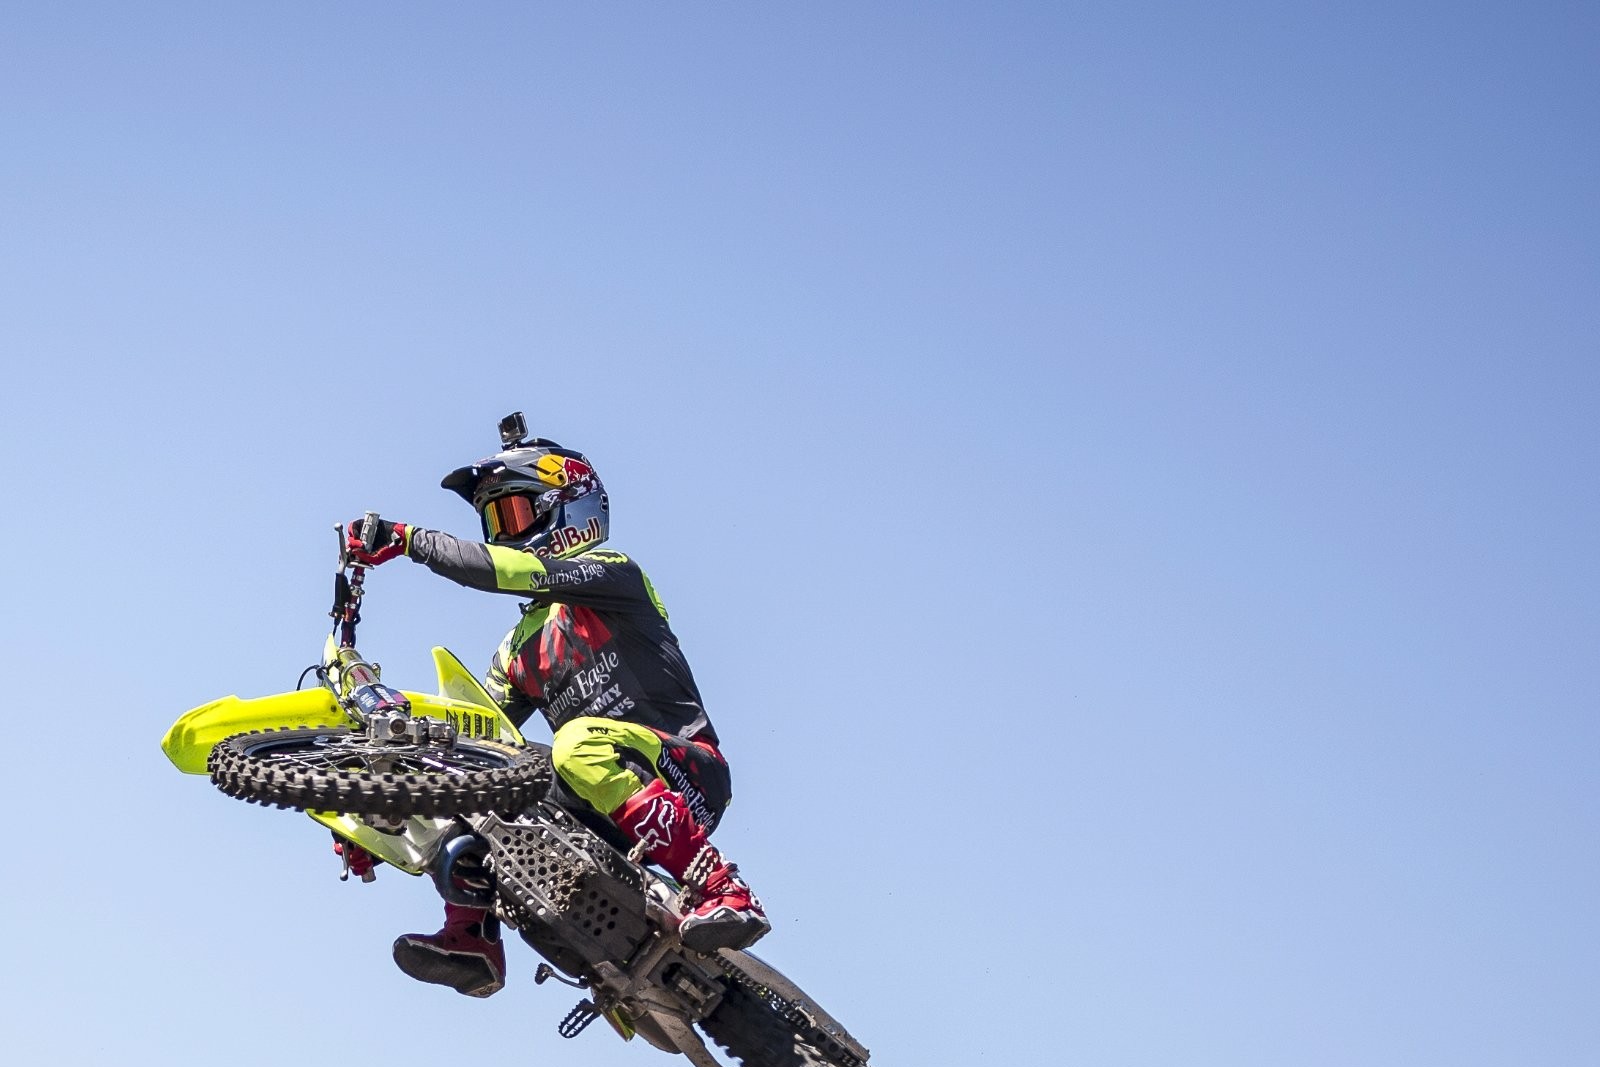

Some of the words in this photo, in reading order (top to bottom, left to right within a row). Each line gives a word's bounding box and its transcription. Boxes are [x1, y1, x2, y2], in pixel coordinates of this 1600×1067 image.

[561, 516, 602, 550] Bull
[530, 569, 582, 591] Soaring
[573, 651, 619, 700] Eagle
